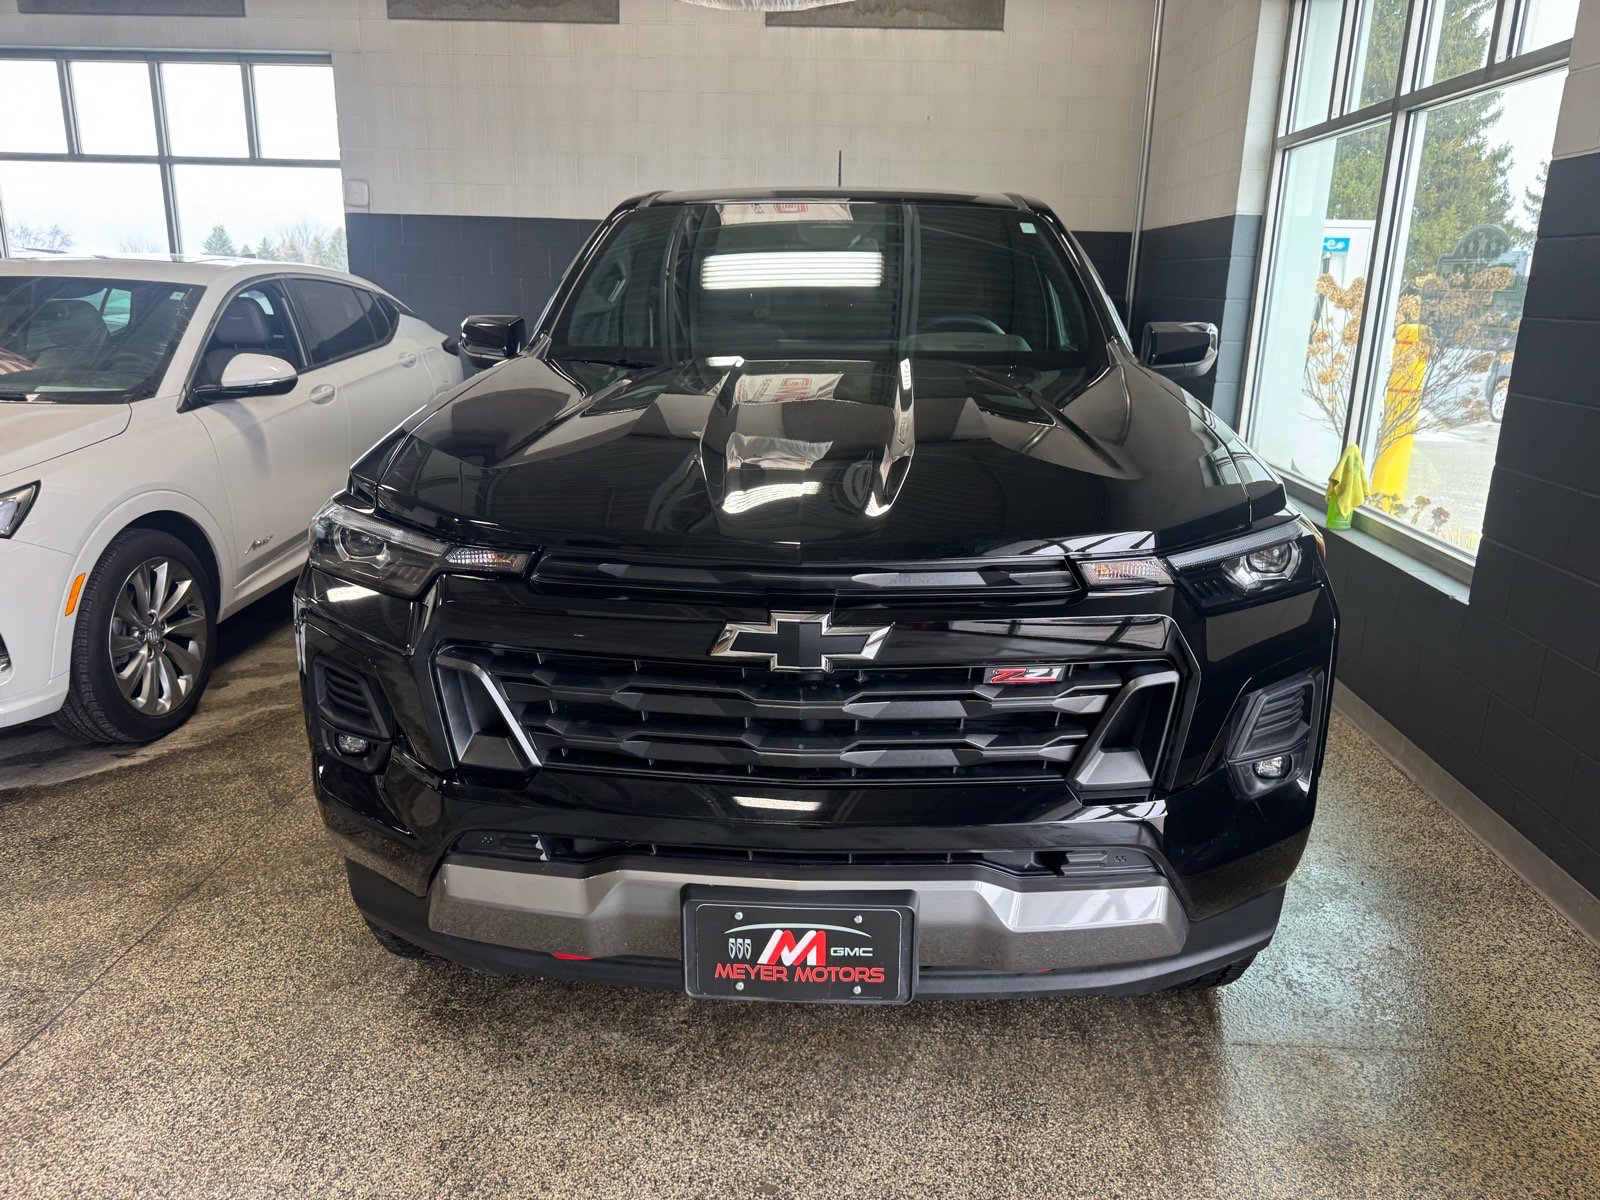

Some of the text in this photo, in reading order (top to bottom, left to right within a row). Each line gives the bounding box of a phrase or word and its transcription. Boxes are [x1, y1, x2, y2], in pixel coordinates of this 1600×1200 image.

[830, 946, 873, 957] GMC
[714, 963, 885, 983] MEYER MOTORS
